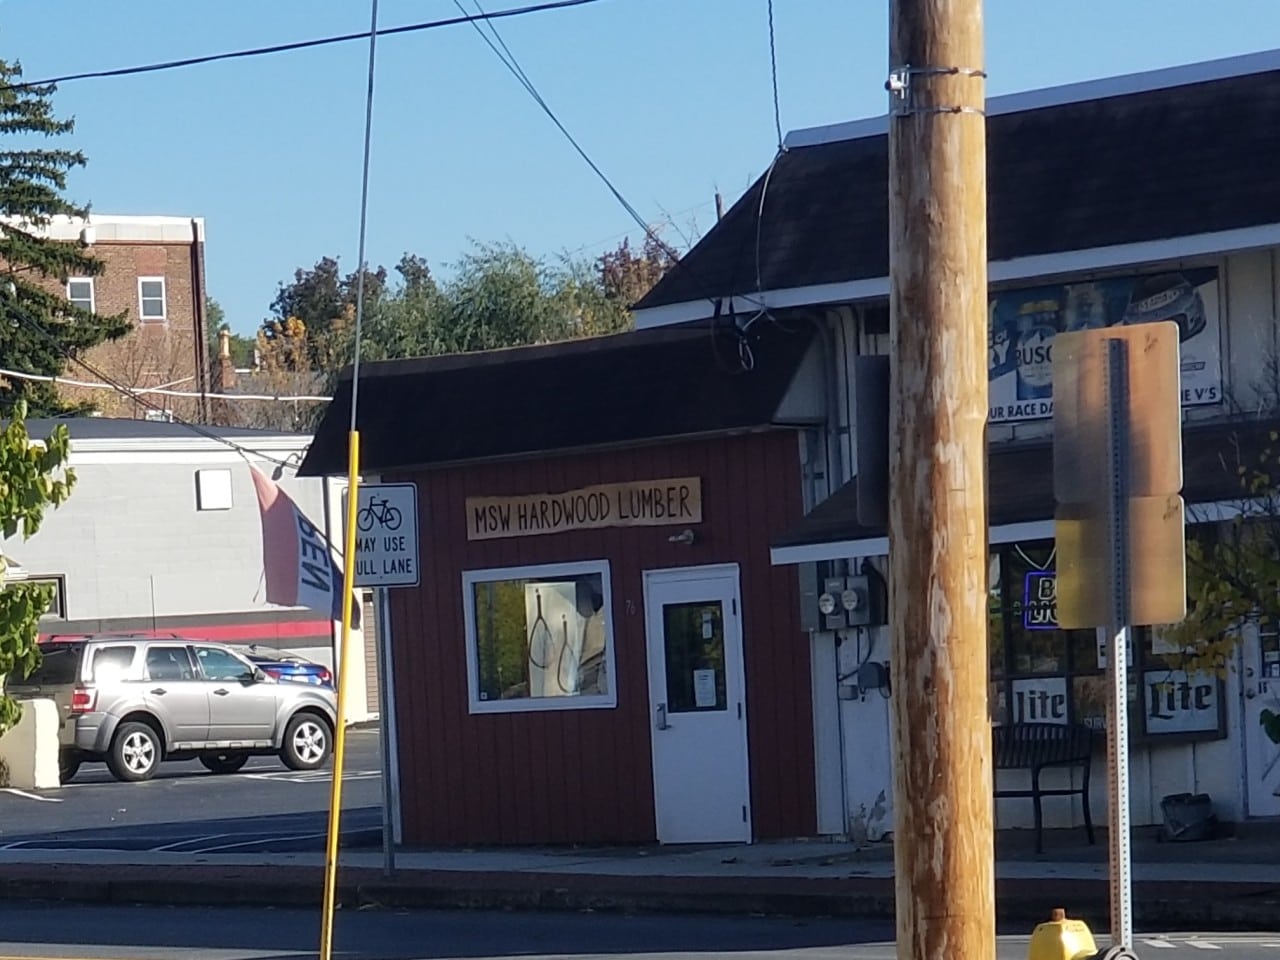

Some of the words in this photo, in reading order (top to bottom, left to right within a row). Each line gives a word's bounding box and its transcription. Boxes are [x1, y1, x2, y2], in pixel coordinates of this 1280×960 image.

[989, 406, 1004, 419] UR
[1007, 403, 1036, 417] RACE
[1194, 386, 1217, 401] V'S
[474, 503, 511, 534] MSW
[517, 492, 611, 531] HARDWOOD
[617, 485, 693, 520] LUMBER
[383, 536, 406, 552] USE
[356, 559, 377, 576] ULL
[383, 558, 413, 575] LANE
[1148, 681, 1213, 720] Lite
